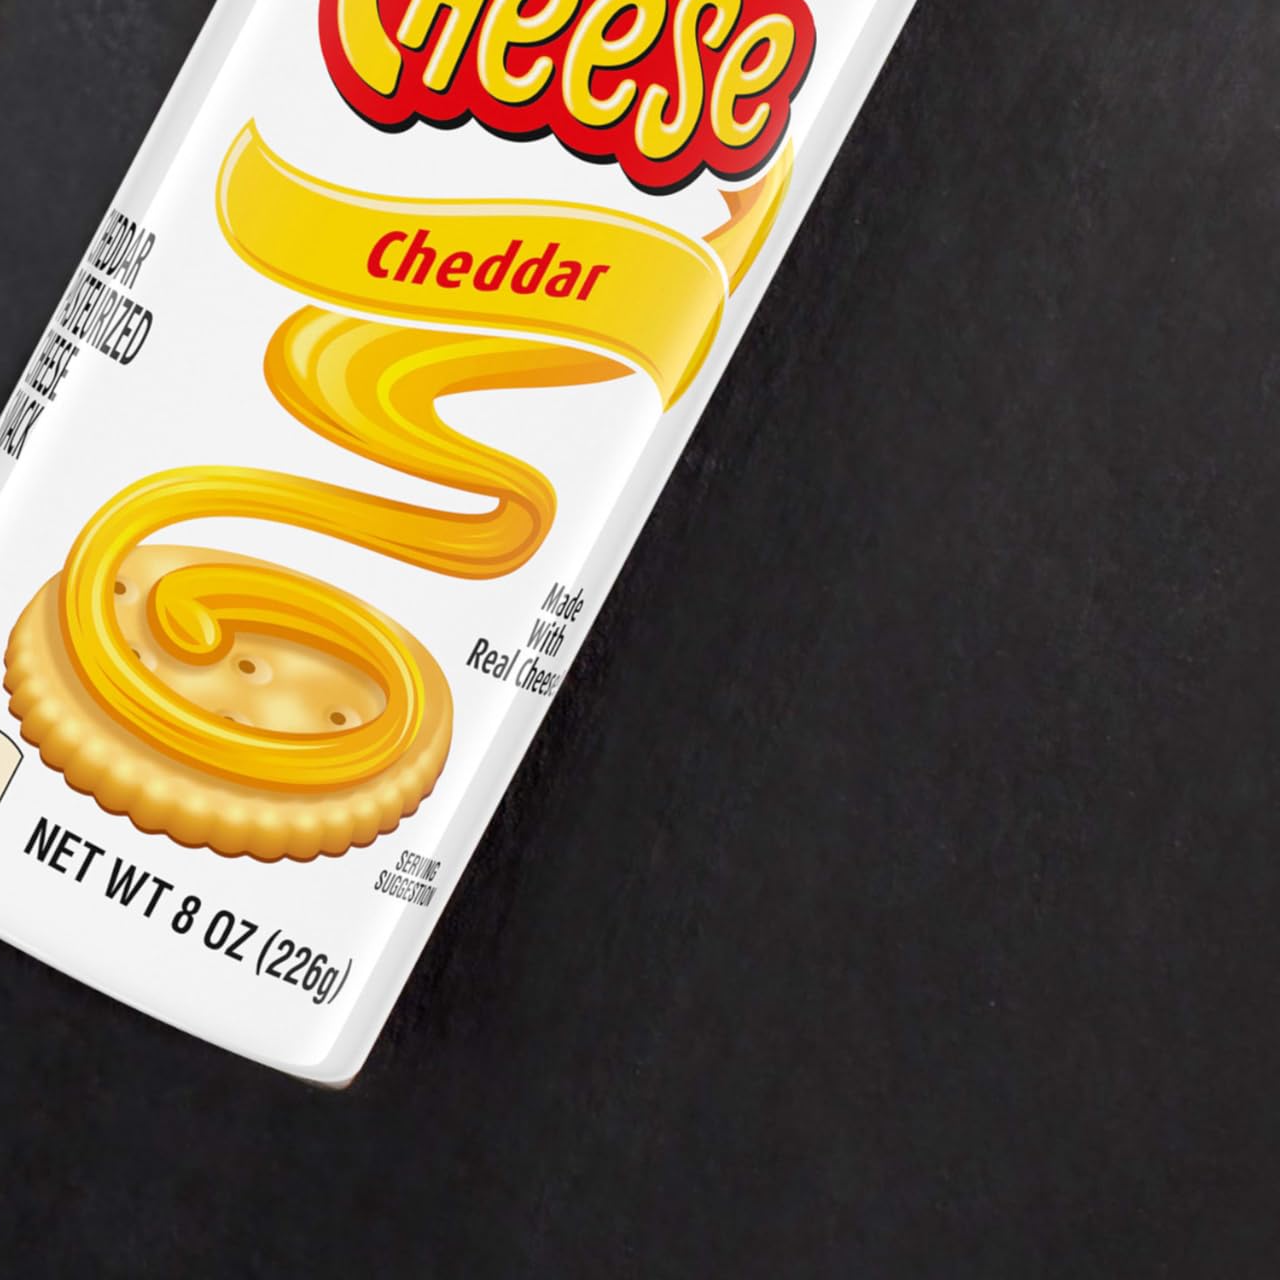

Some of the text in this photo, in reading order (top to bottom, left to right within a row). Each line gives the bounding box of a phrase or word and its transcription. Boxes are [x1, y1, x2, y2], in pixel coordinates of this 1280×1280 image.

[366, 228, 610, 302] Cheddar
[541, 582, 584, 622] Made
[526, 618, 567, 657] With
[466, 637, 521, 681] Real
[395, 849, 441, 882] SERVING
[374, 869, 437, 907] SUGGESTION
[23, 816, 353, 1005] NET WT 8 OZ (226g)
